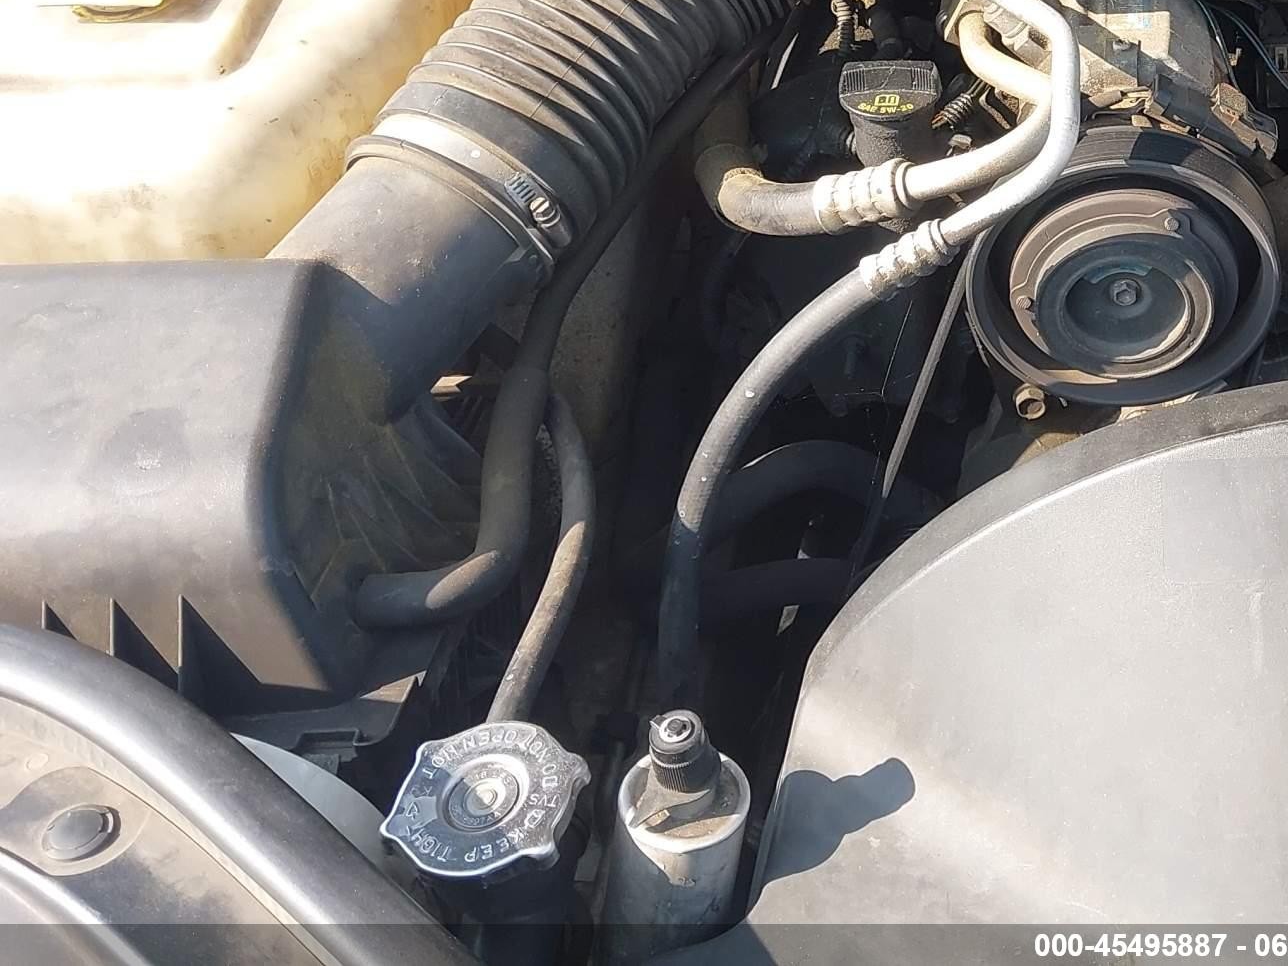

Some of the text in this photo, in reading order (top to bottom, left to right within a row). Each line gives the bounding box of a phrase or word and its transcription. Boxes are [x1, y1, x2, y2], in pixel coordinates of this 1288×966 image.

[857, 102, 914, 114] SAE 5W-20
[463, 729, 518, 752] OPEN
[519, 732, 552, 764] NOT
[541, 762, 559, 789] DO
[528, 793, 562, 808] TVS
[464, 828, 526, 863] KEEP
